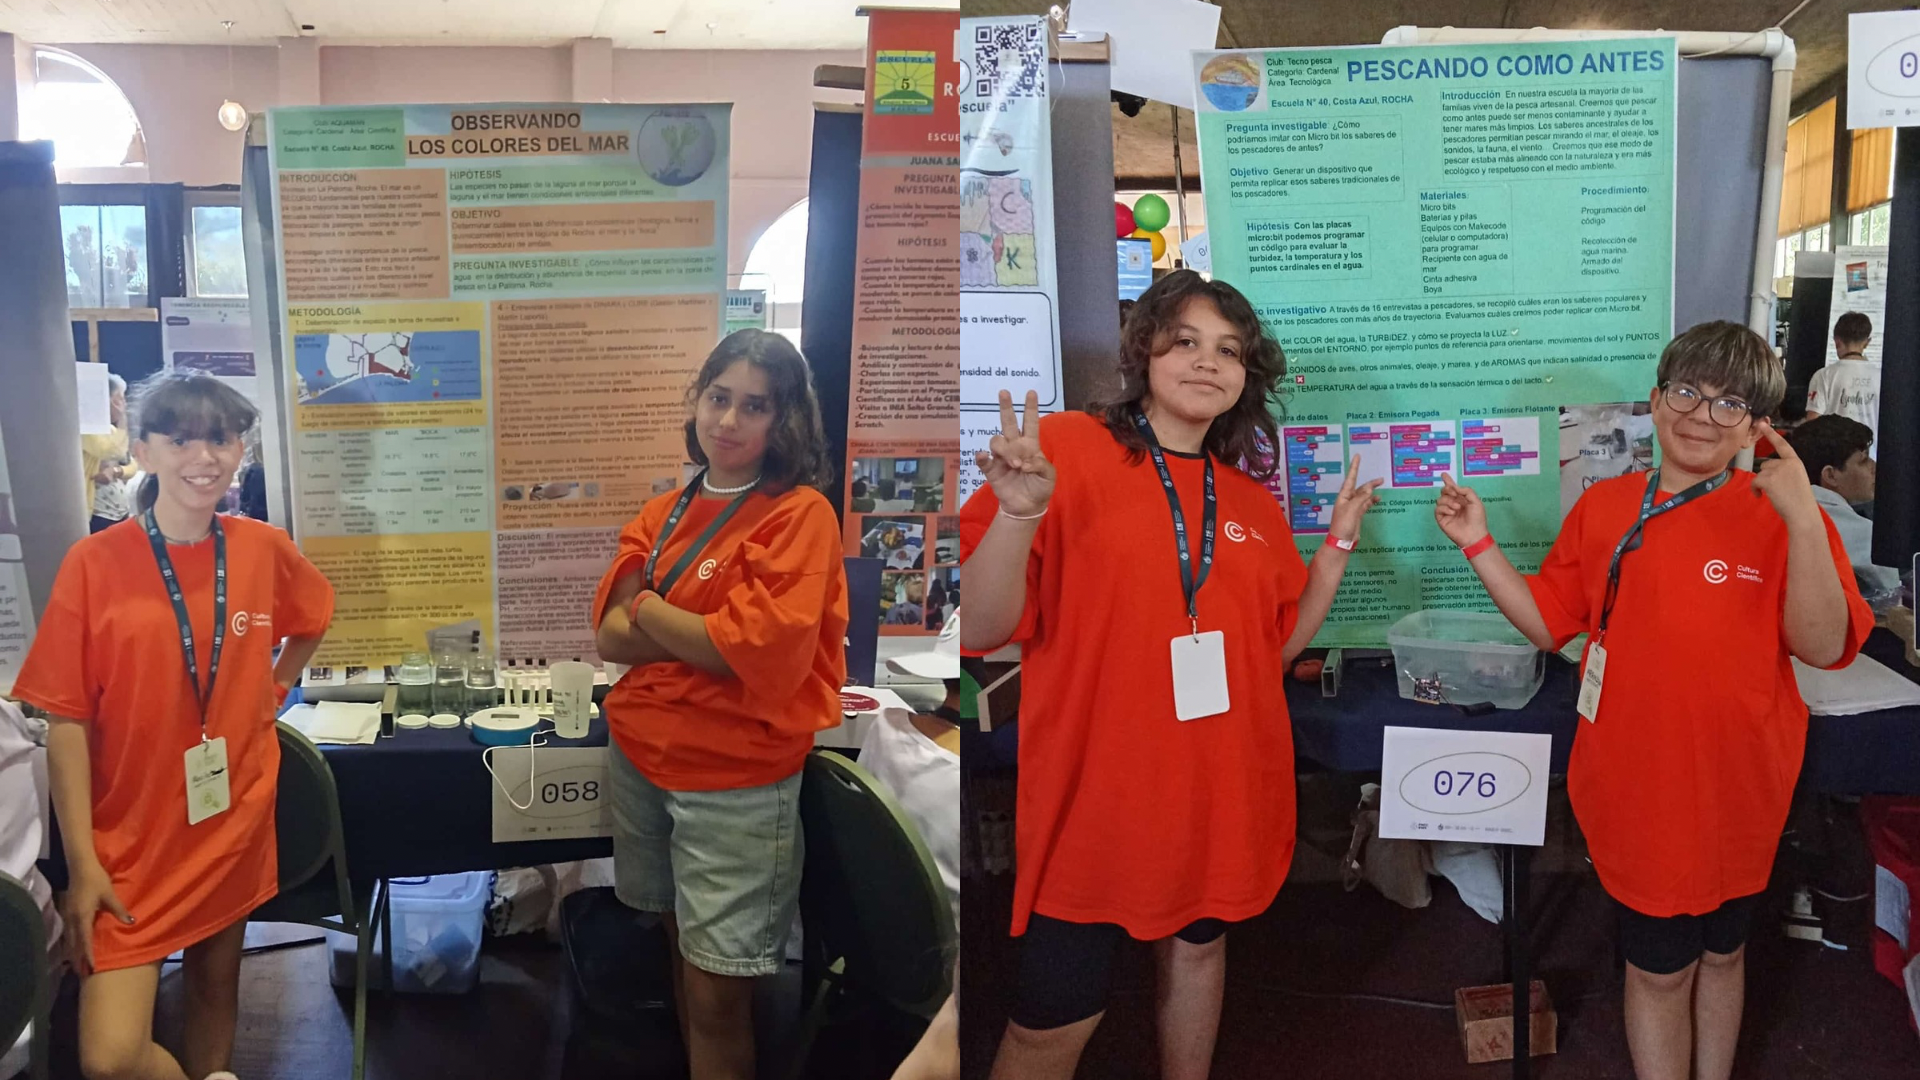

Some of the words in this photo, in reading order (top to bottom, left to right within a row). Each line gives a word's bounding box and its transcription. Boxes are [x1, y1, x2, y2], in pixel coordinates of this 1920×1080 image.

[1347, 58, 1488, 82] PESCANDO
[1497, 54, 1573, 76] COMO
[1580, 51, 1664, 73] ANTES
[901, 79, 910, 91] 5
[452, 114, 580, 130] OBSERVANDO
[409, 140, 445, 155] LOS
[452, 137, 541, 154] COLORES
[547, 137, 583, 152] DEL
[589, 136, 629, 151] MAR
[1241, 145, 1284, 155] pescadores
[910, 157, 943, 165] JUANA
[450, 170, 502, 180] HIPÓTESIS
[904, 174, 956, 183] PREGUNTA
[451, 210, 501, 219] OBJETIVO
[1326, 221, 1352, 230] placas
[898, 237, 947, 247] HIPÓTESIS
[1285, 233, 1322, 241] podemos
[1261, 244, 1288, 253] código
[1006, 247, 1021, 270] K
[1294, 253, 1342, 262] temperatura
[453, 261, 506, 270] PREGUNTA
[509, 259, 579, 268] INVESTIGABLE
[1250, 265, 1278, 273] puntos
[288, 307, 361, 317] METODOLOGÍA
[981, 314, 1028, 326] investigar.
[995, 367, 1008, 376] del
[1011, 368, 1040, 377] sonido.
[1435, 771, 1495, 798] 076
[542, 781, 598, 804] 058
